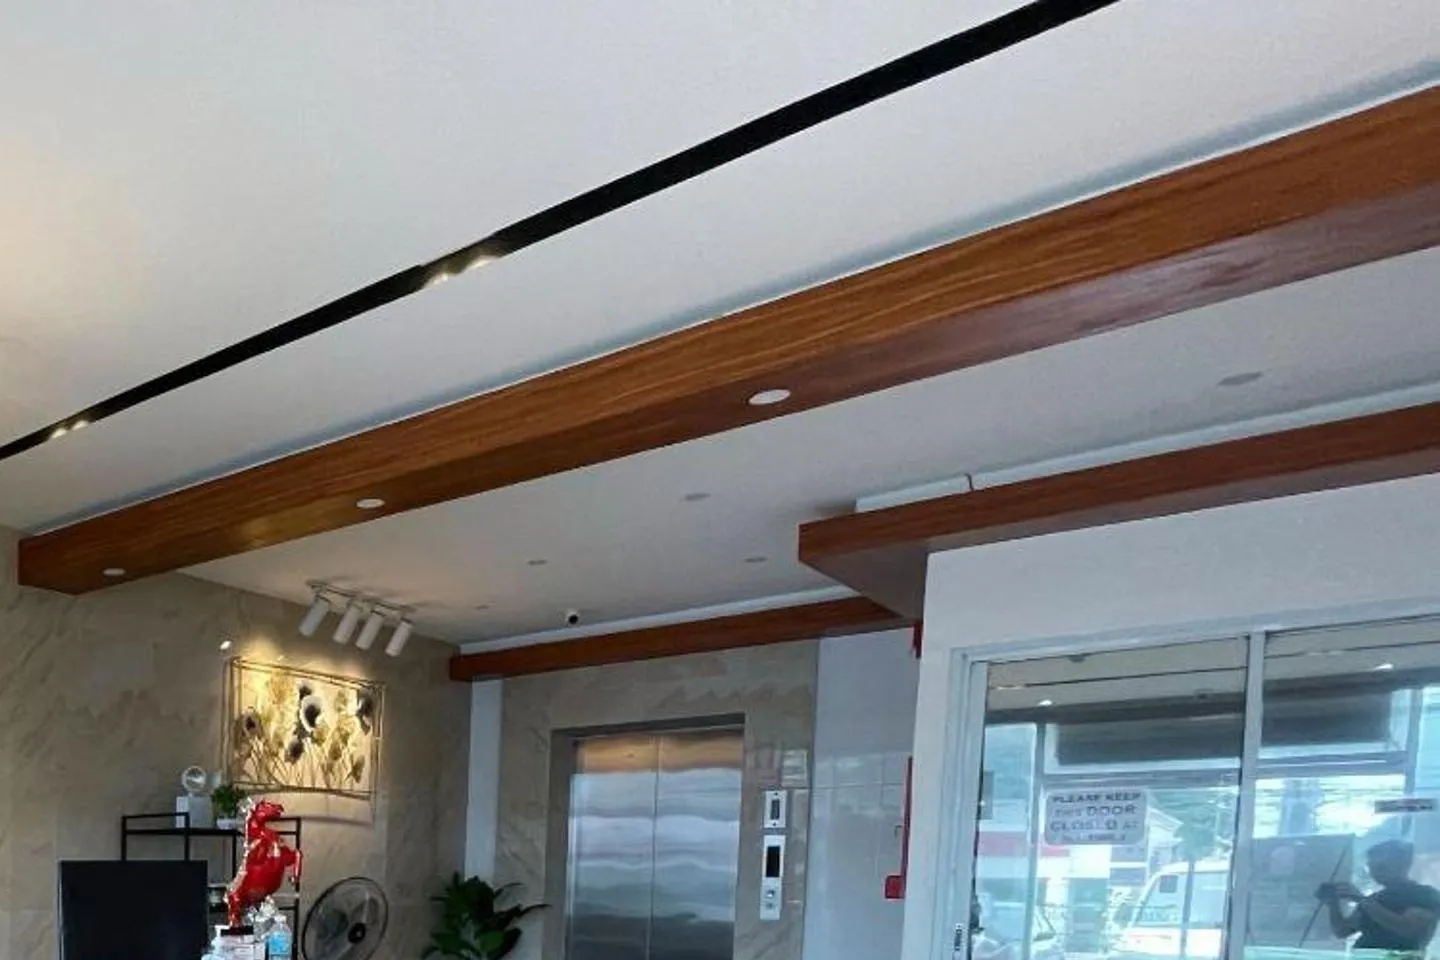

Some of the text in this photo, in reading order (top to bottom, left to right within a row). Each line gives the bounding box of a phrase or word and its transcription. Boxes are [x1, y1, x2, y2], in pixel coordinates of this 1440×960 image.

[1051, 791, 1142, 804] PLEASE KEEP
[1085, 805, 1137, 816] DOOR
[1049, 819, 1119, 832] CLOSED
